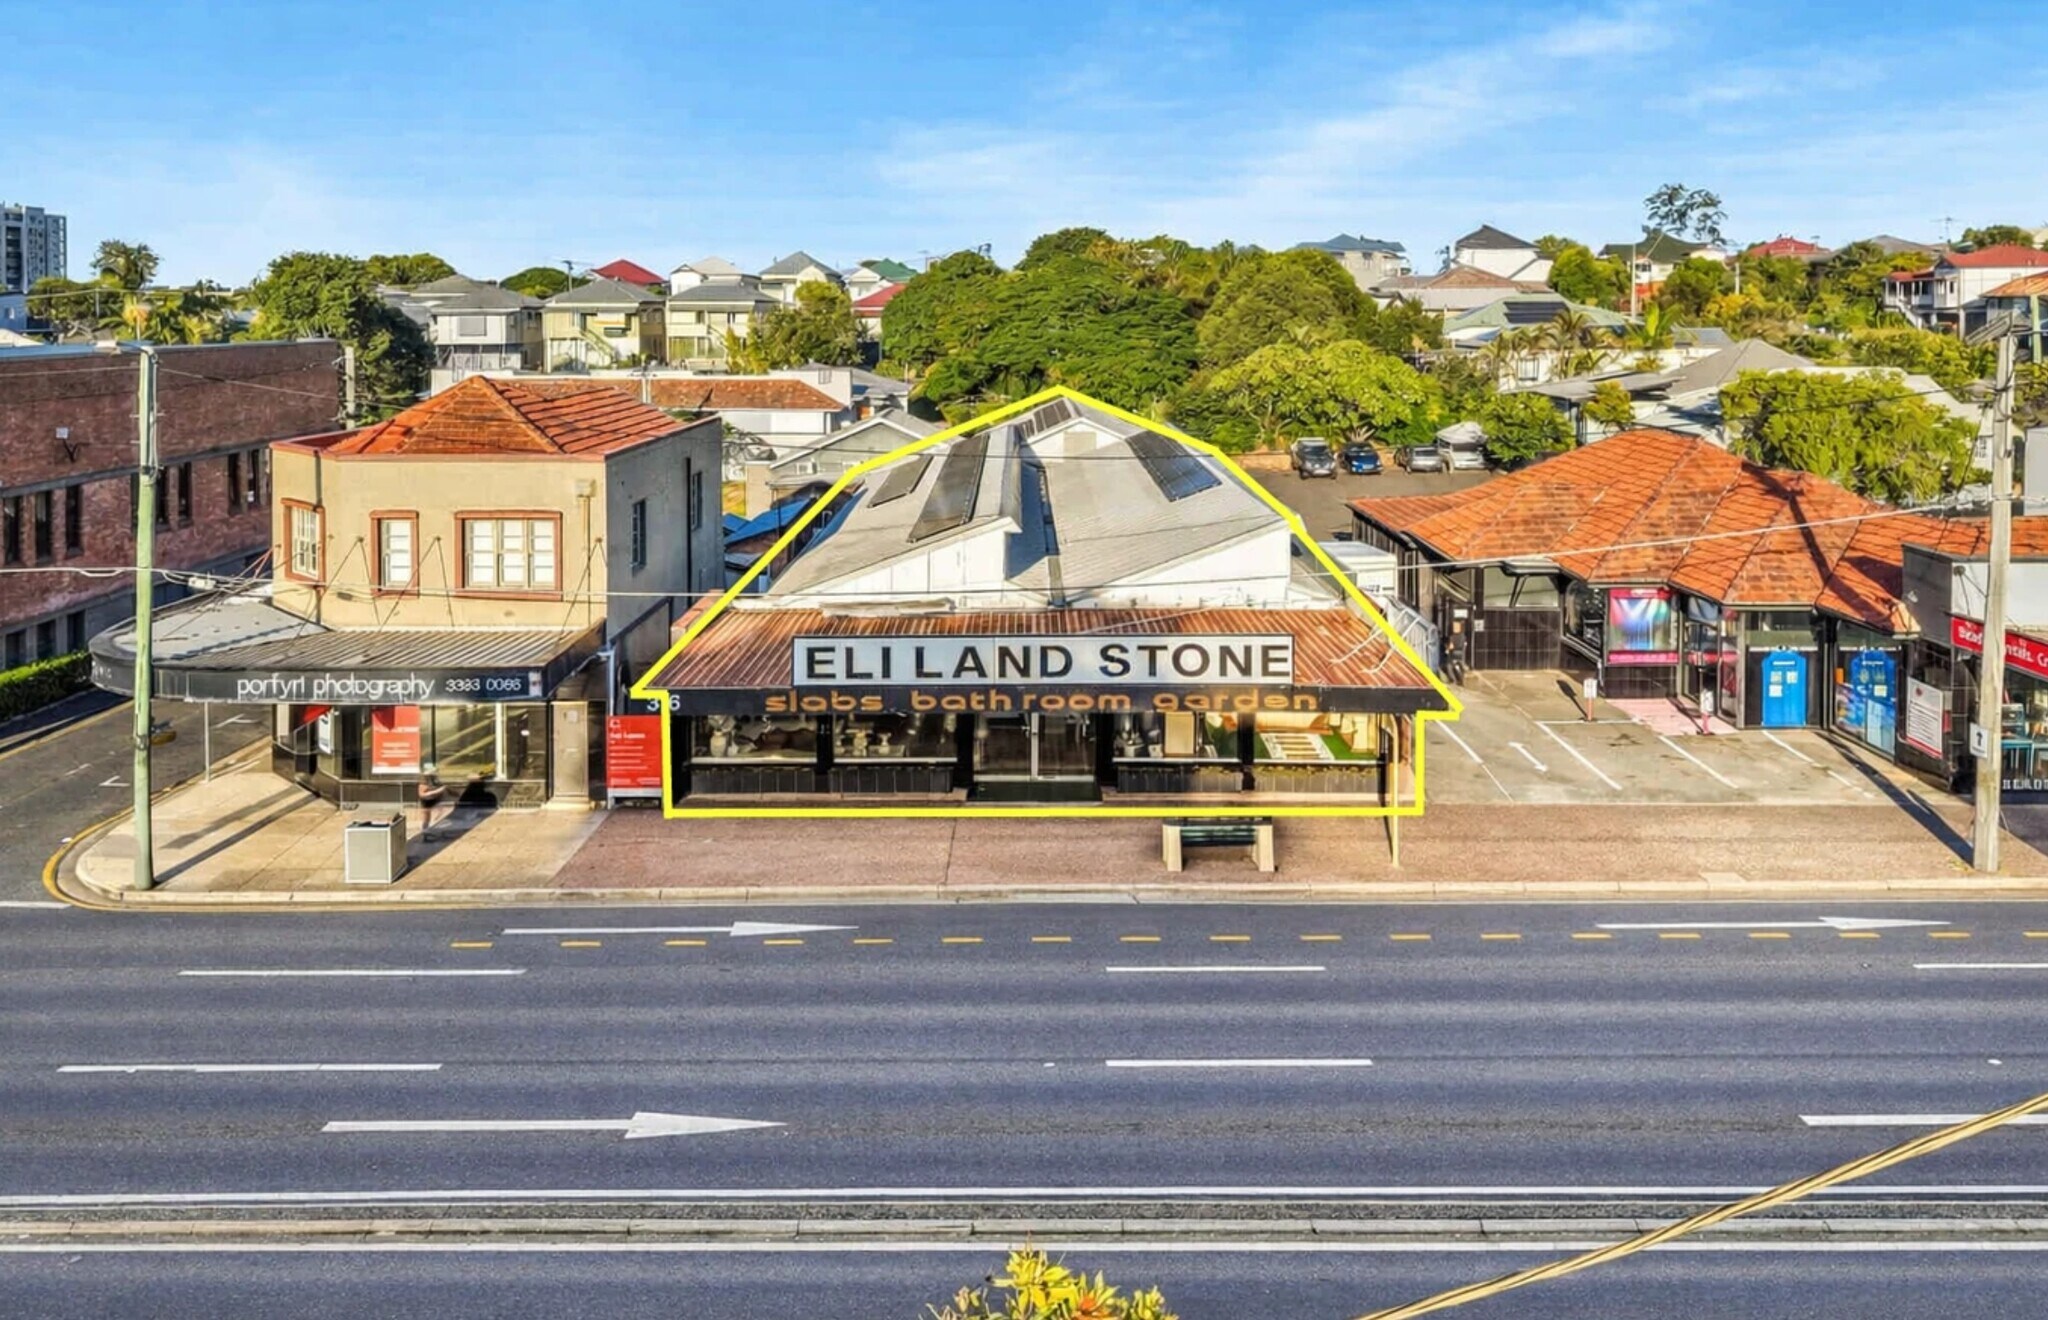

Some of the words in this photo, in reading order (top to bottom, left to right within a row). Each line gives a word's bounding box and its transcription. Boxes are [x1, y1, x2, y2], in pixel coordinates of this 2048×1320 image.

[806, 645, 892, 680] ELI
[914, 645, 1073, 679] LAND
[1098, 643, 1290, 678] STONE
[313, 672, 436, 702] photography
[764, 689, 884, 712] slabs
[1152, 688, 1319, 712] garden
